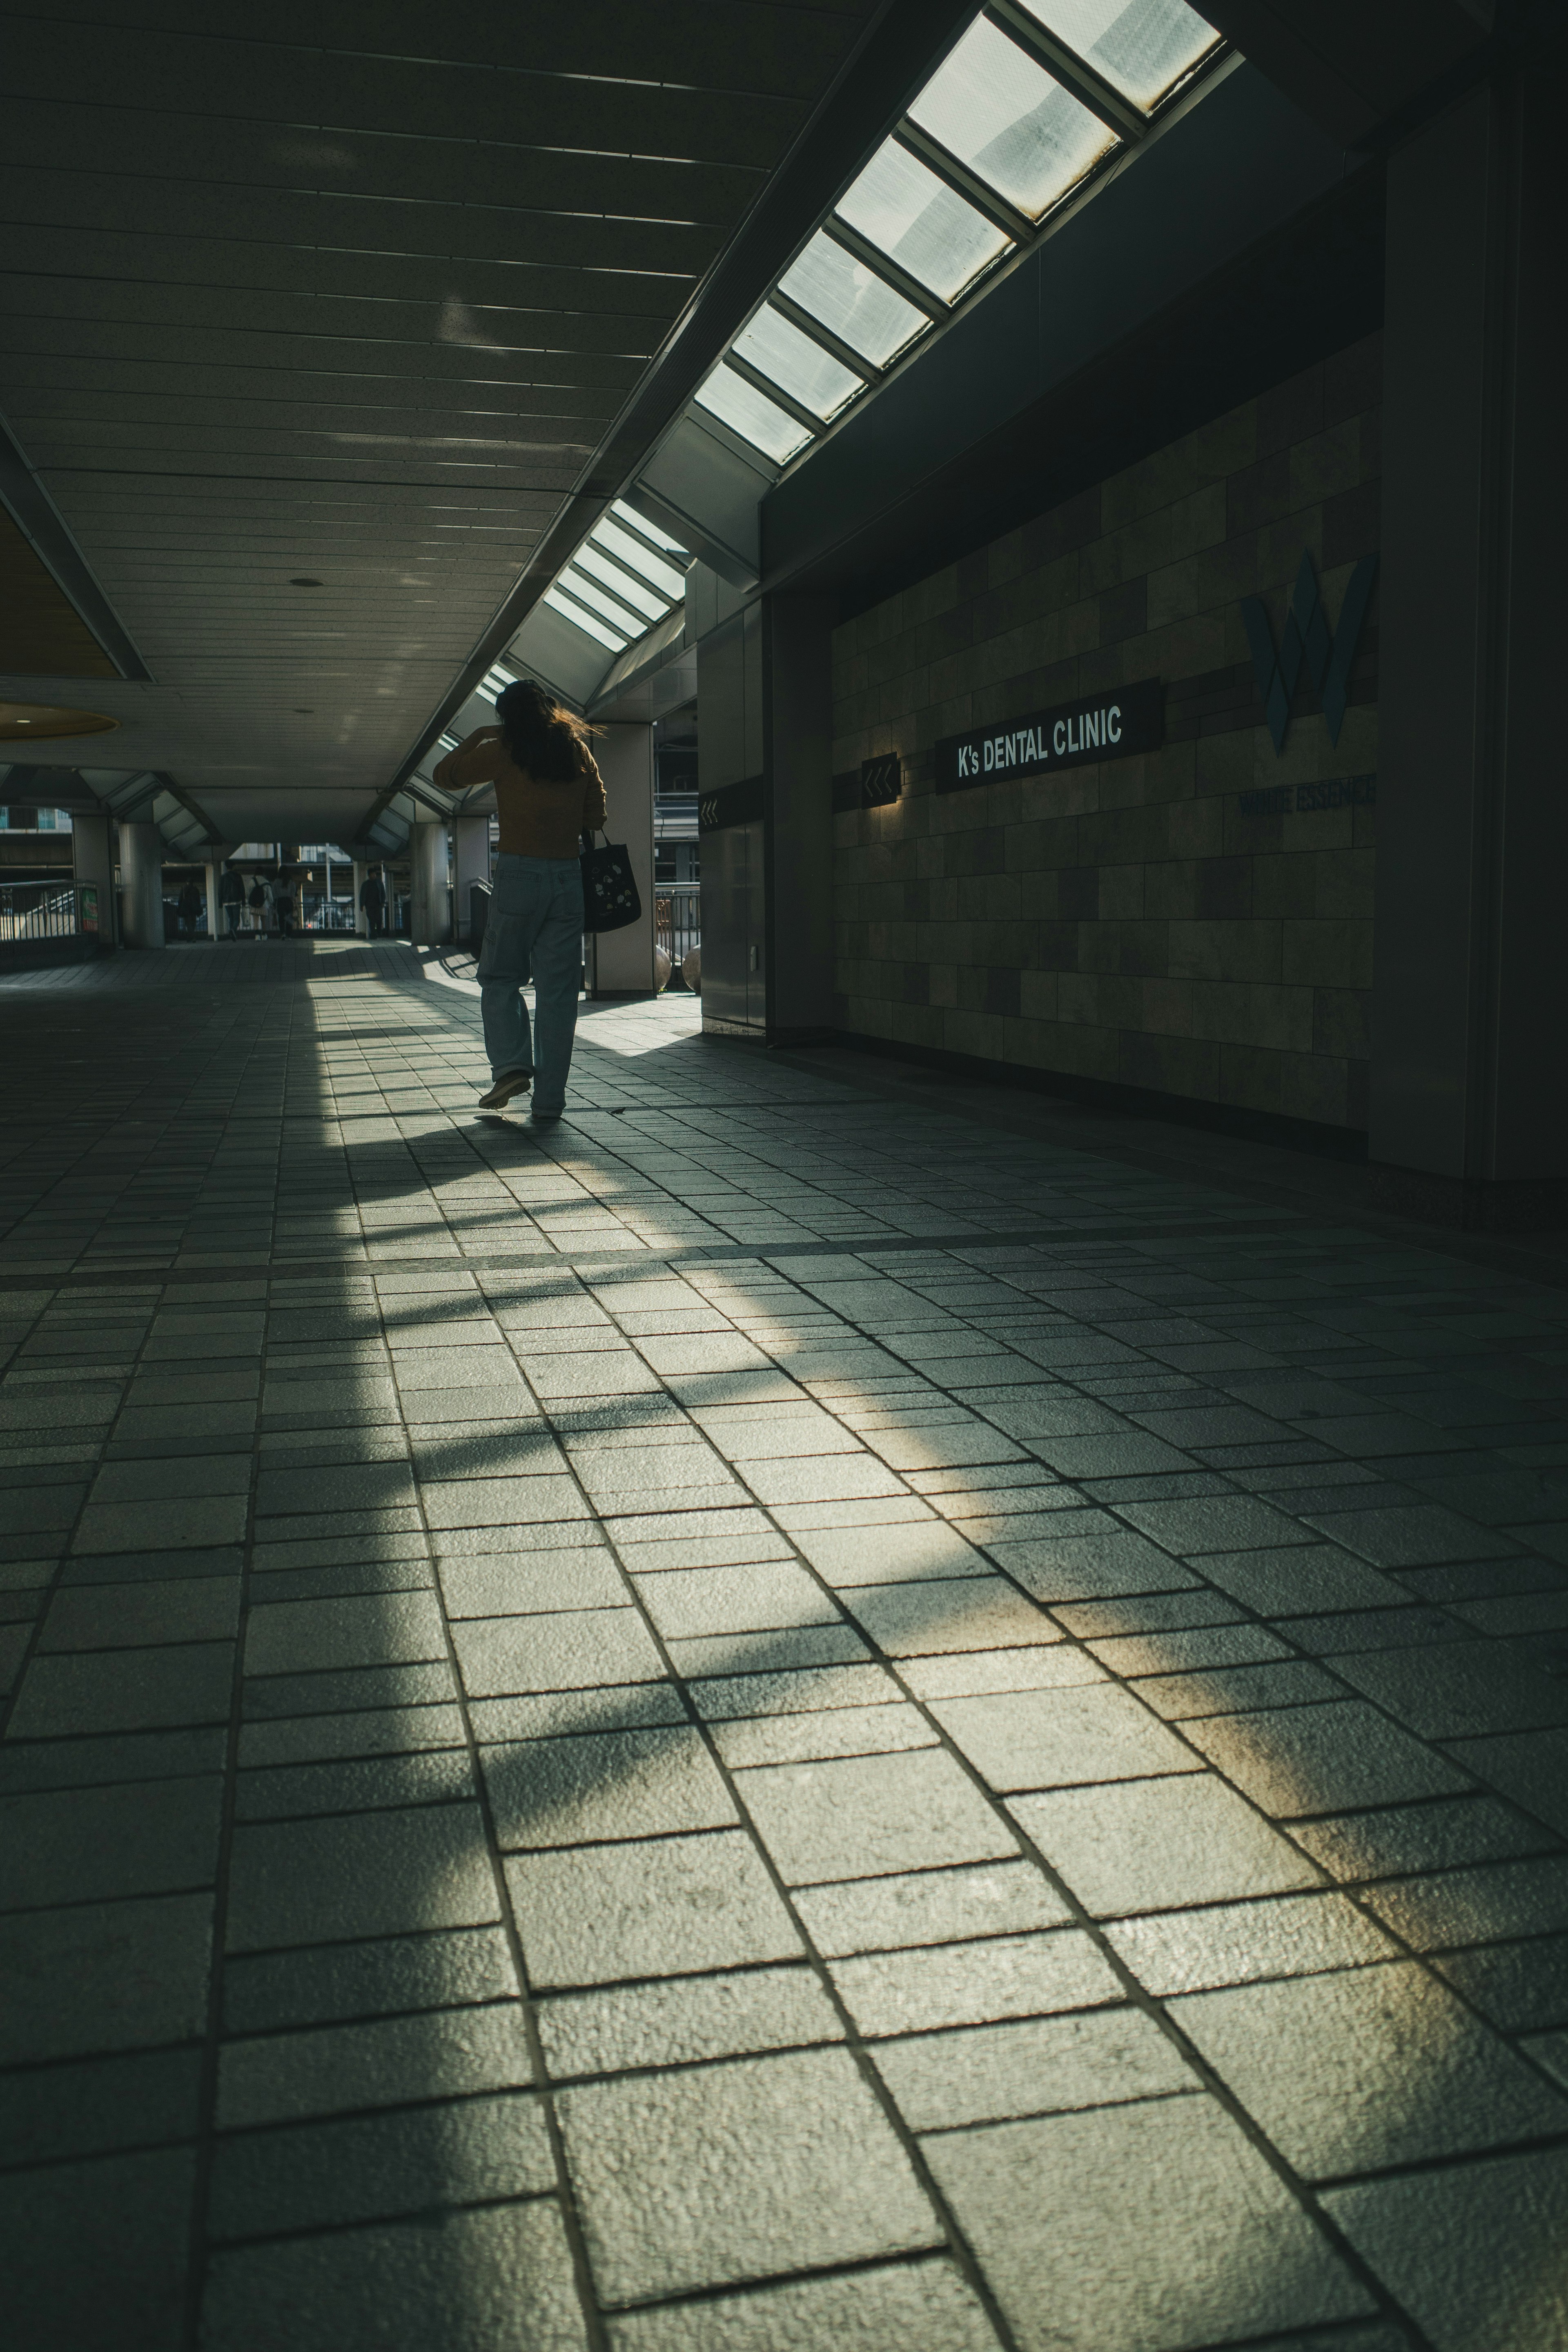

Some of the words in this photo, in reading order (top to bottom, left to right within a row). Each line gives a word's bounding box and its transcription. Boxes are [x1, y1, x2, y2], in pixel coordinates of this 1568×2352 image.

[958, 745, 979, 777] K's
[984, 726, 1048, 771] DENTAL
[1054, 706, 1122, 755] CLINIC
[1239, 788, 1292, 817] WHITE
[1296, 775, 1376, 811] ESSENCE
